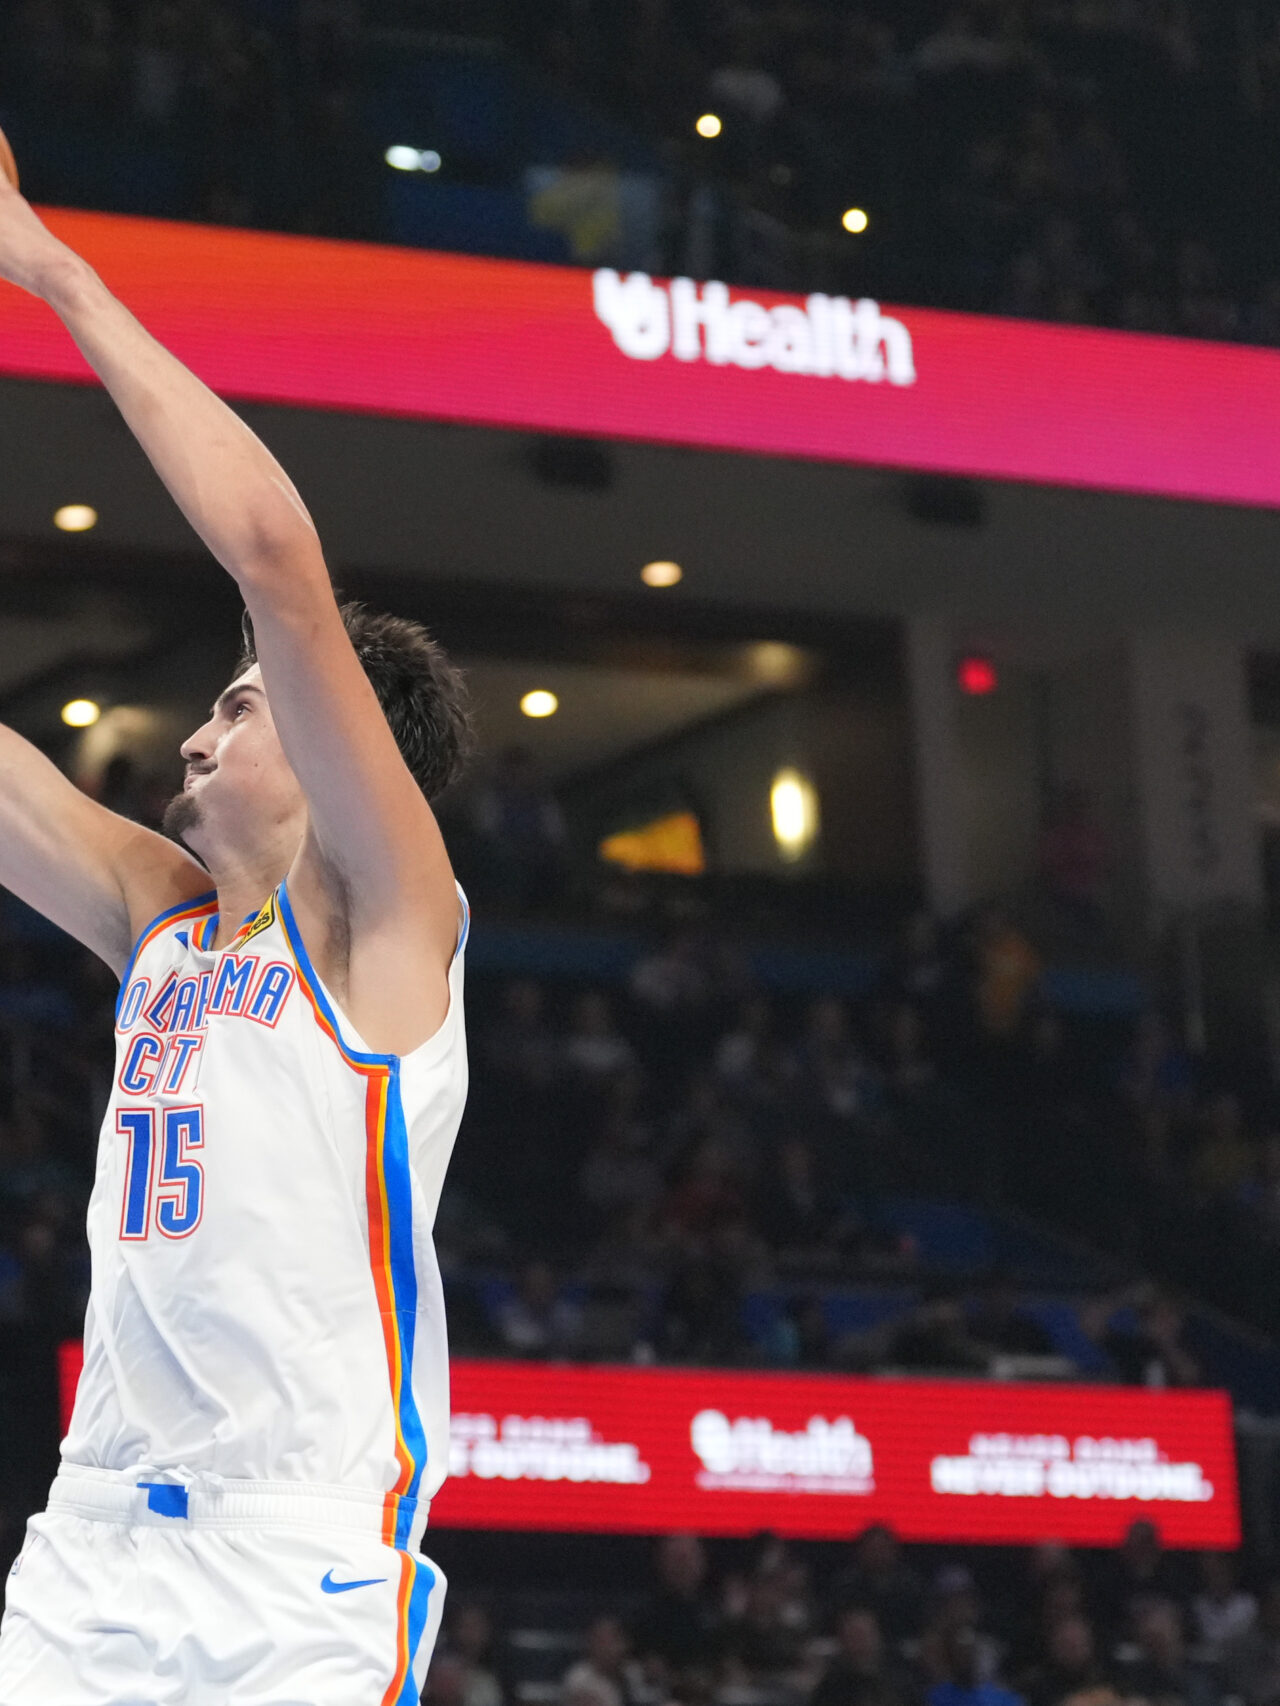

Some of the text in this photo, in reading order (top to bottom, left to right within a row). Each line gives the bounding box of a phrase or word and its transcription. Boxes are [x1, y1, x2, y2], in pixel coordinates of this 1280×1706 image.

[670, 277, 916, 387] Health
[118, 1032, 204, 1097] CIT
[116, 1103, 205, 1241] 15
